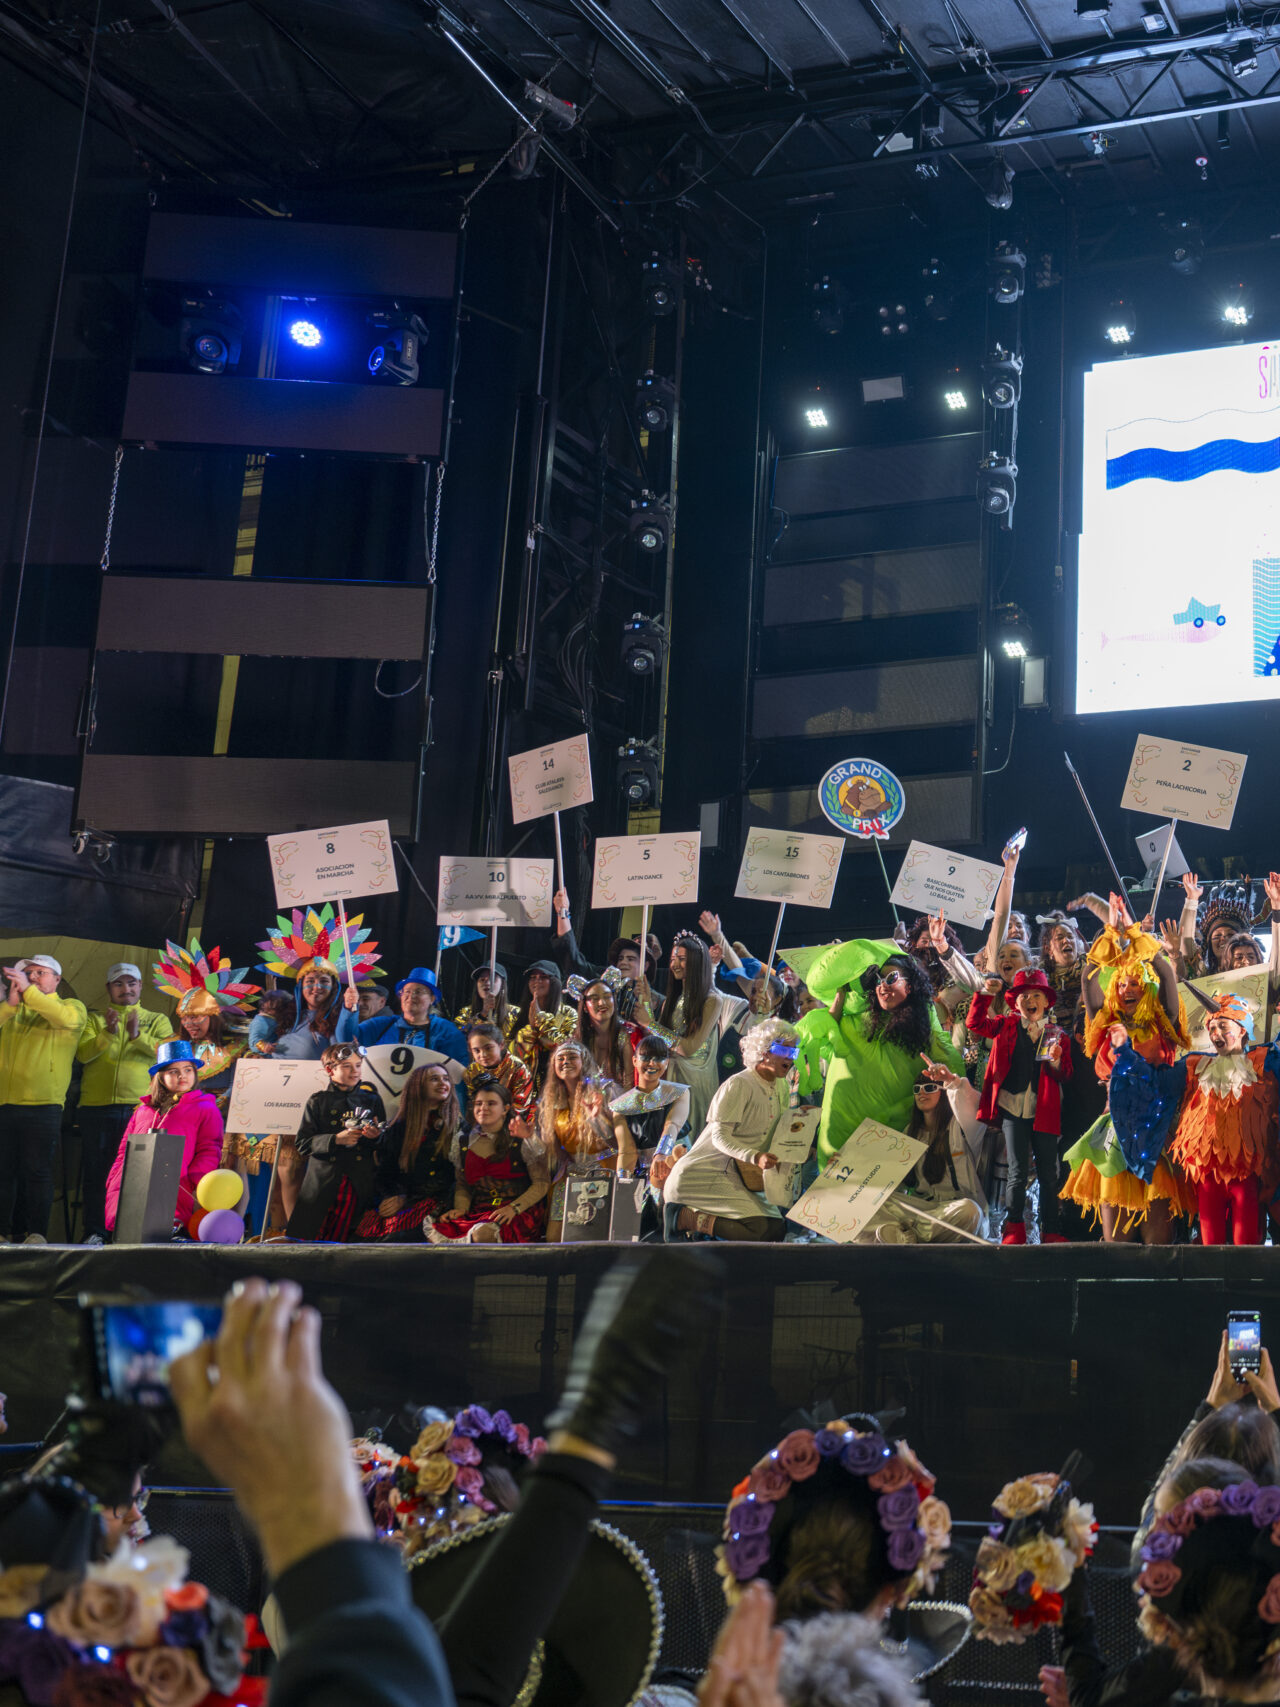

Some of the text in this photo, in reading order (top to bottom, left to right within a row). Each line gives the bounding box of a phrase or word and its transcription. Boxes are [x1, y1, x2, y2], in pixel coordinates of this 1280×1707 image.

[542, 758, 554, 771] 14
[1182, 759, 1192, 771] 2
[829, 763, 882, 784] GRAND
[1156, 779, 1171, 788] PEÑA
[852, 814, 889, 831] PRIX
[326, 842, 335, 854] 8
[785, 846, 800, 858] 15
[642, 849, 651, 860] 5
[326, 870, 354, 879] MARCHA
[488, 871, 505, 882] 10
[947, 866, 956, 876] 9
[923, 883, 965, 899] QUE NOS QUITEN
[443, 925, 460, 947] 9
[390, 1047, 415, 1075] 9
[282, 1074, 291, 1086] 7
[836, 1166, 854, 1183] 12
[863, 1164, 881, 1185] STUDIO
